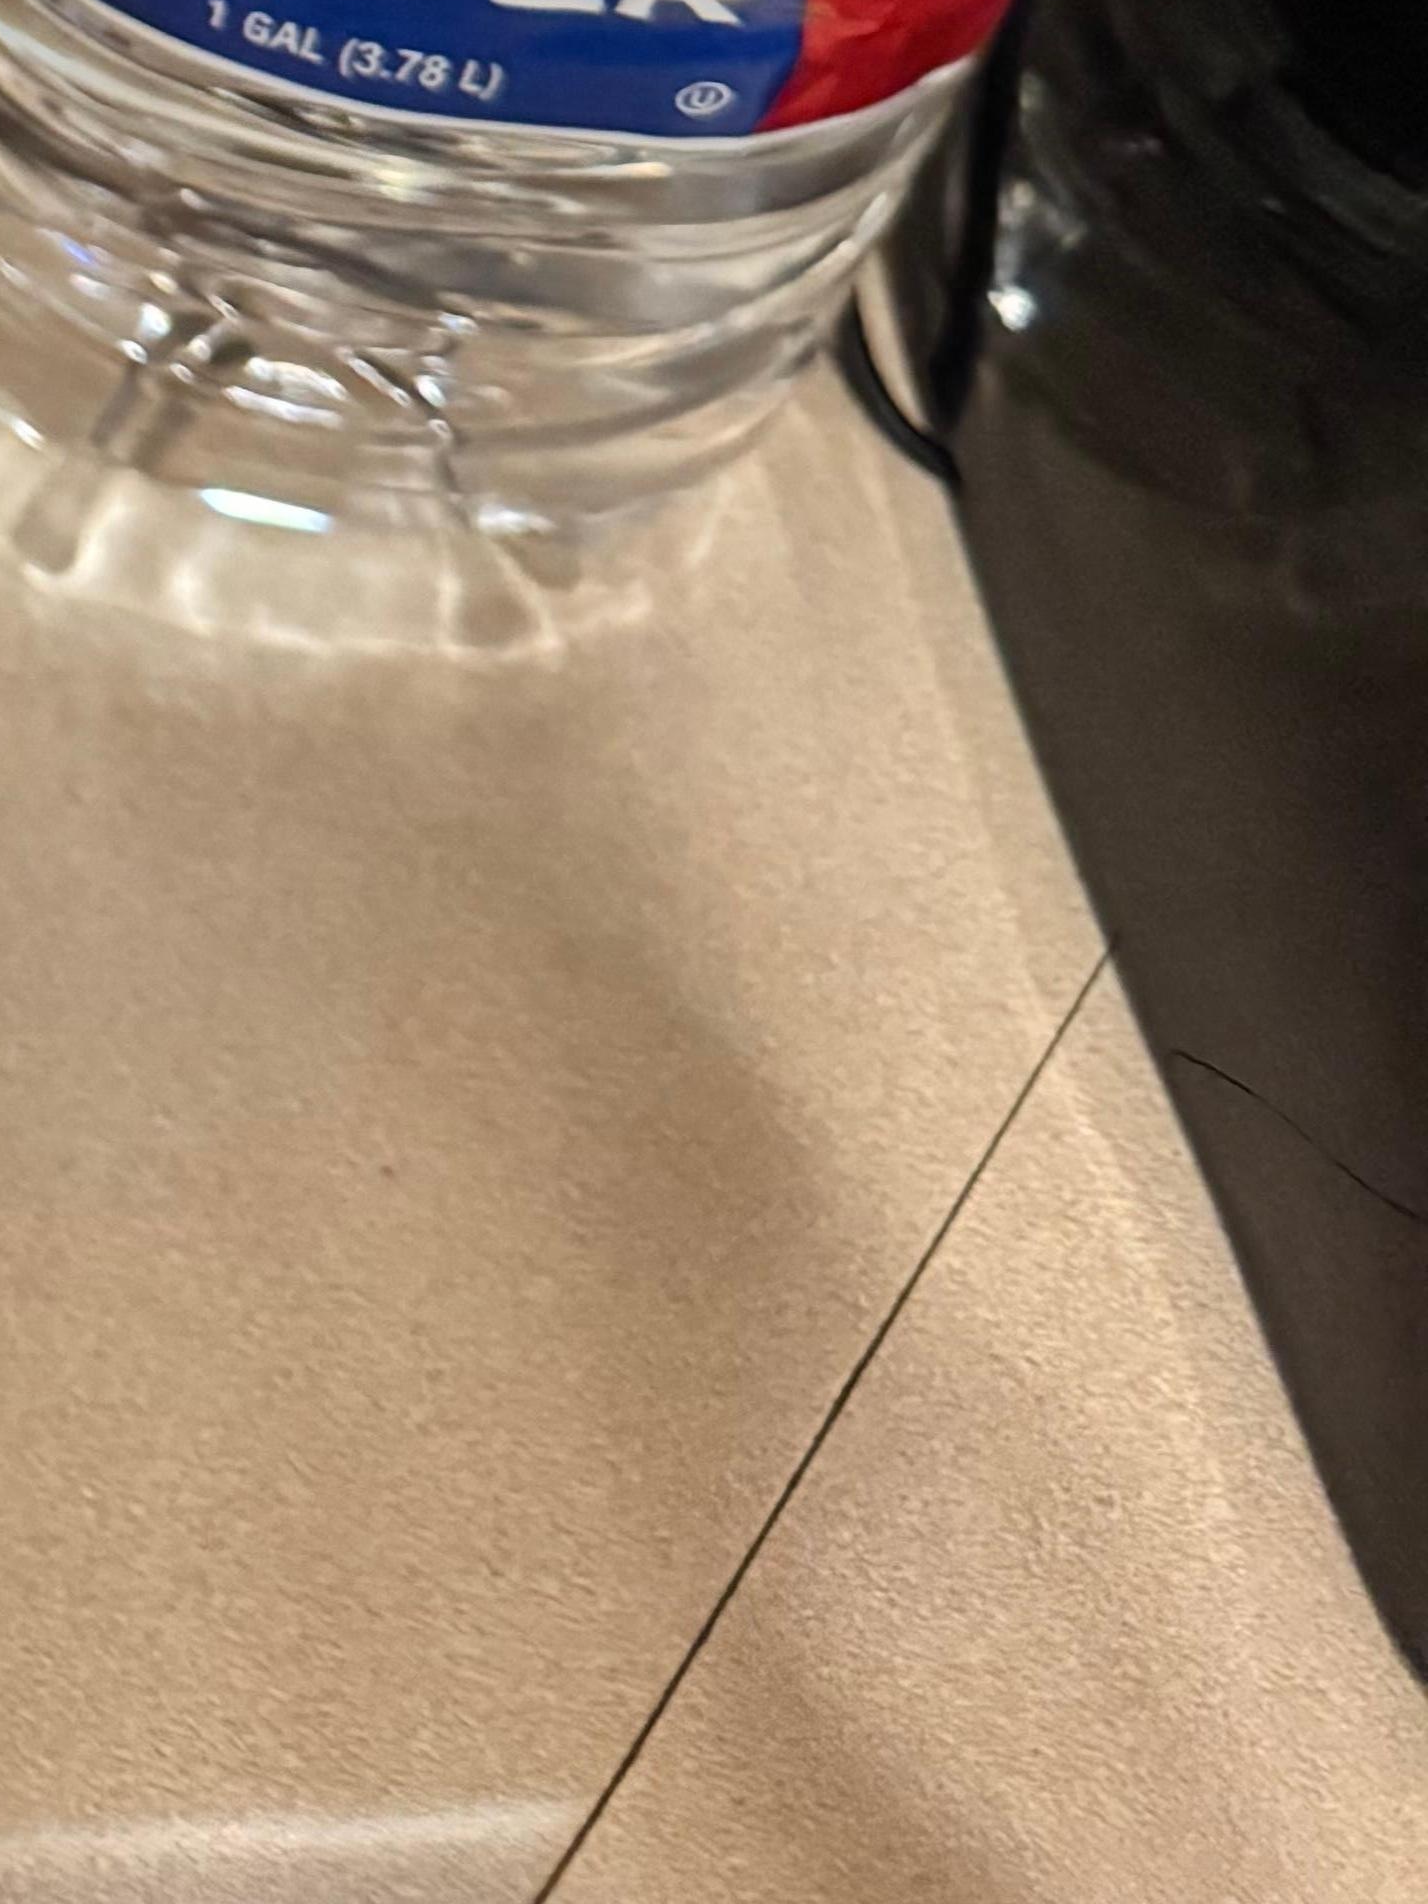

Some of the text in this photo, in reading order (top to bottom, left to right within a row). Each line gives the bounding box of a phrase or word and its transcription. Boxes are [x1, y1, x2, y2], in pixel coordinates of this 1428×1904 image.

[242, 10, 325, 64] GAL
[338, 38, 450, 90] (3.78
[458, 58, 506, 100] L)
